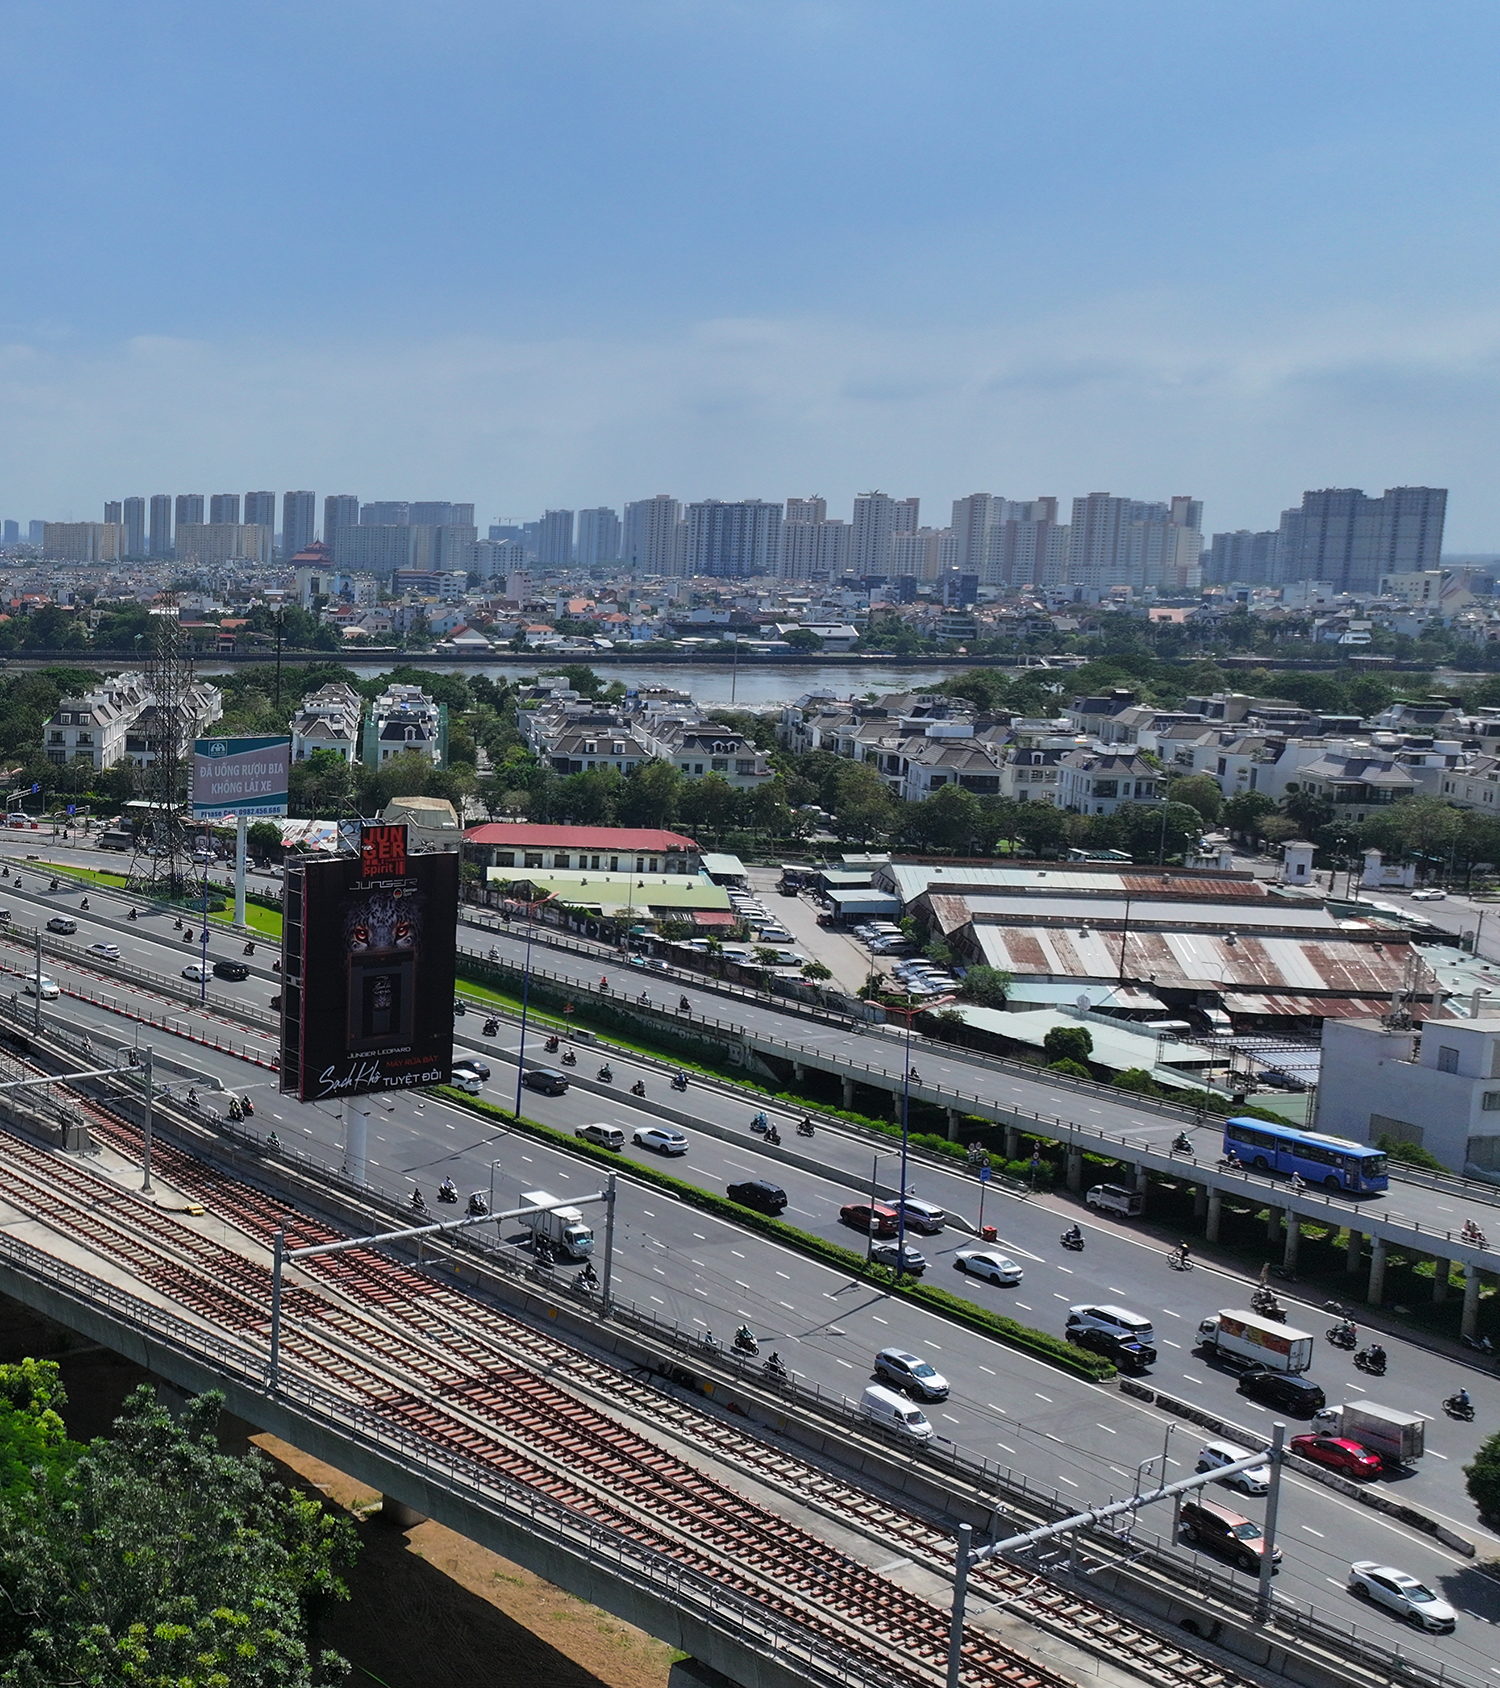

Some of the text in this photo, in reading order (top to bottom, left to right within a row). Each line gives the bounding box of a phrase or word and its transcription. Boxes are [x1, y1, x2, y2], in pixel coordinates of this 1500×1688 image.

[200, 761, 284, 778] ĐÃ UỐNG RƯỢU BIA
[211, 777, 272, 795] KHÔNG LÁI XE
[349, 878, 418, 891] JUNGER
[315, 1062, 356, 1098] Sạch
[382, 1072, 420, 1087] TUYỆT
